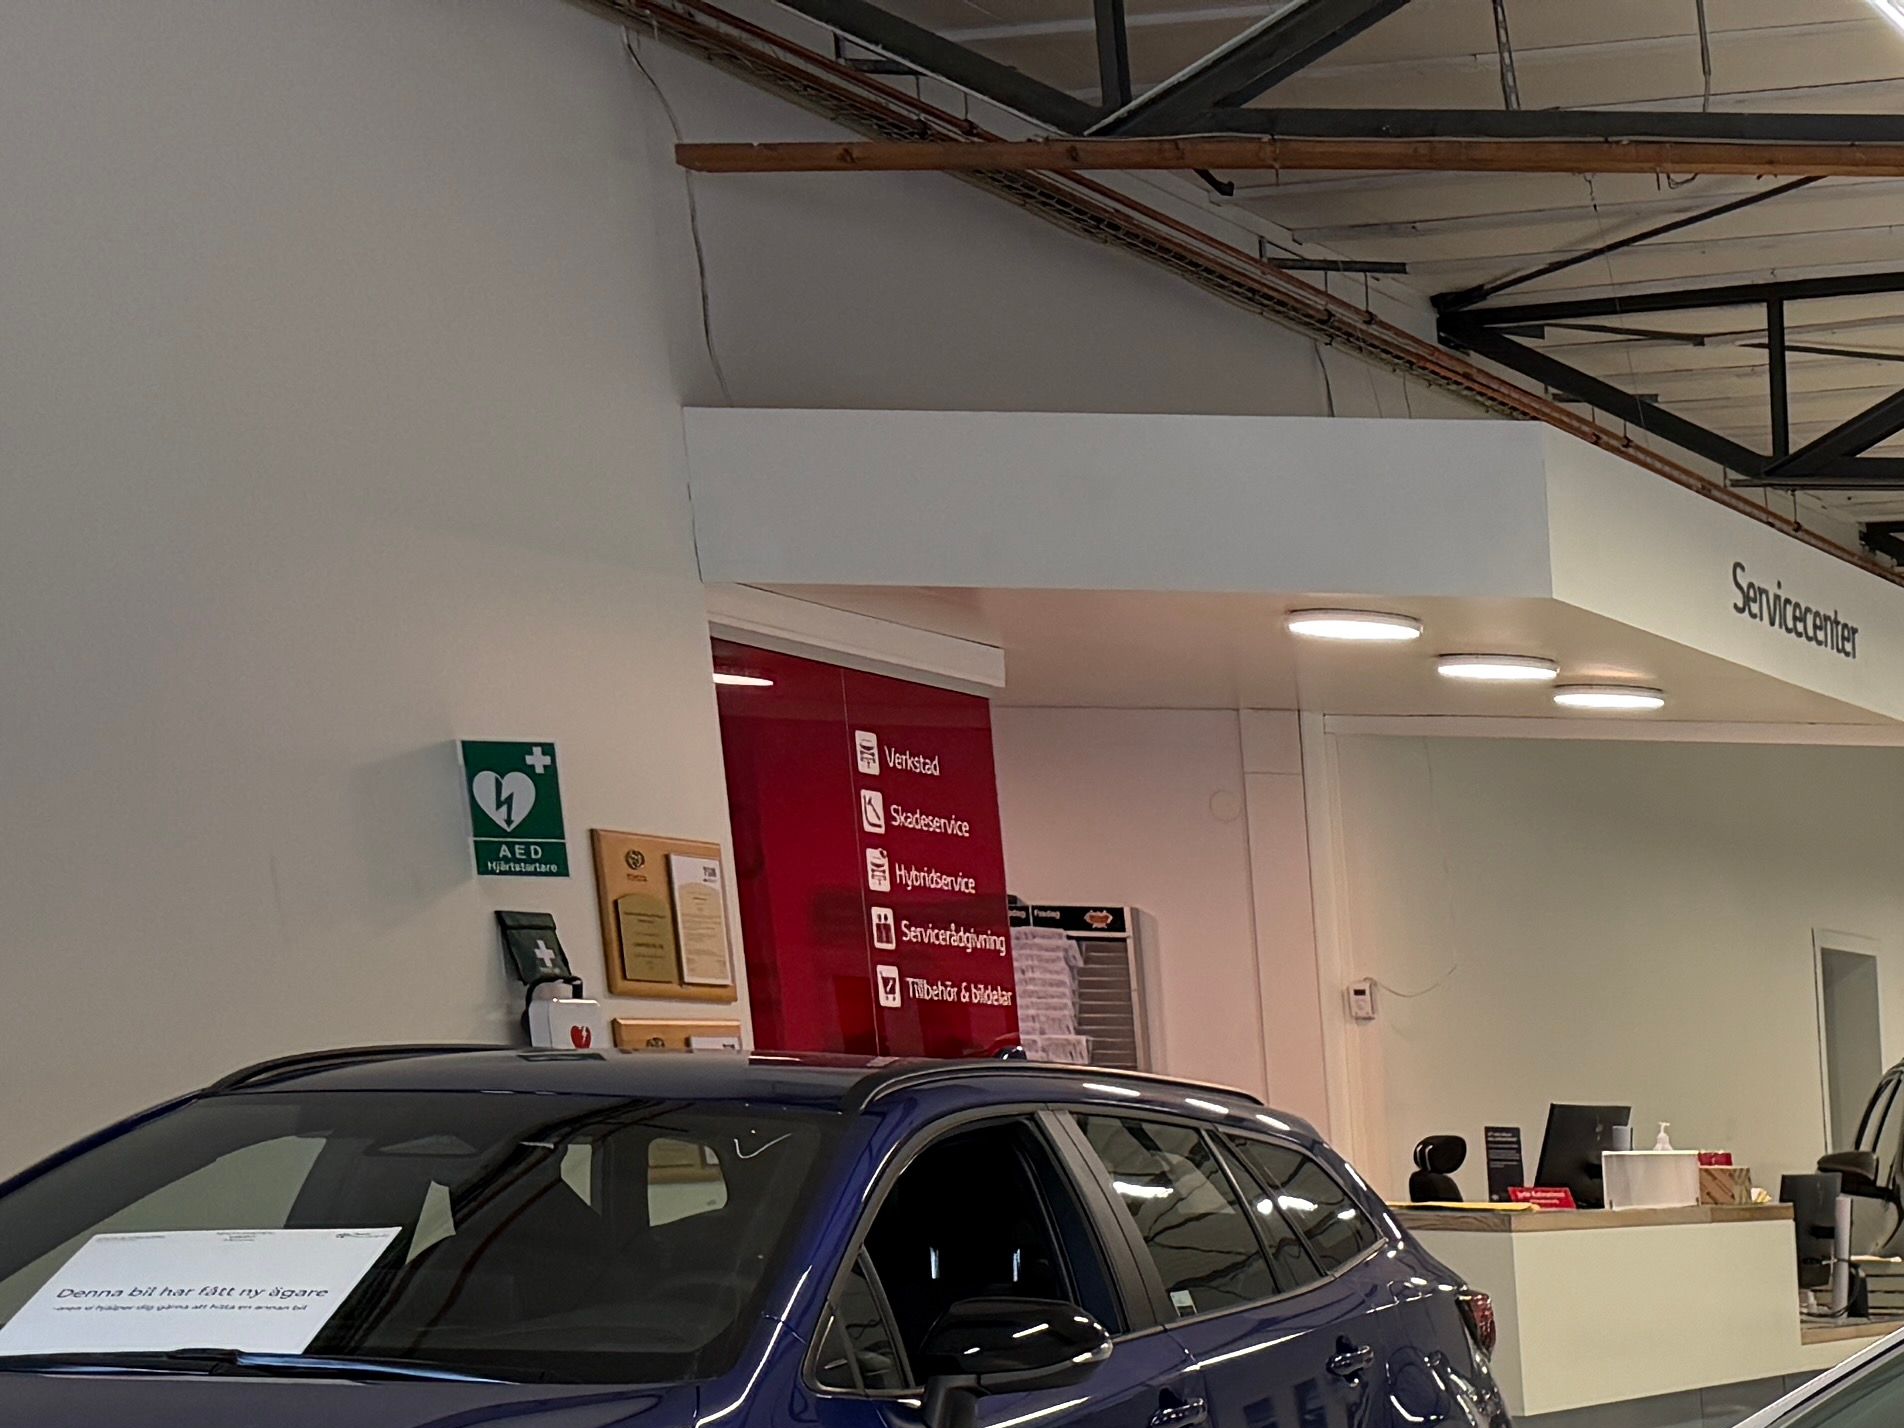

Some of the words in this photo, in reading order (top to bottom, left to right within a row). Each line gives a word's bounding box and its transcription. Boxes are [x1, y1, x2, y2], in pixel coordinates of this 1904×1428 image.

[1732, 561, 1858, 659] Servicecenter
[884, 745, 941, 776] Verkstad
[890, 804, 970, 837] Skadeservice
[487, 861, 558, 873] Hjärtstartare
[499, 844, 542, 859] AED
[895, 862, 976, 894] Hybridservice
[901, 920, 1006, 956] Servicerådgivning
[905, 977, 958, 1002] Tillbehör
[960, 982, 969, 1003] &
[971, 983, 1012, 1006] bildelar
[56, 1288, 124, 1298] Denna
[128, 1286, 157, 1297] bil
[159, 1286, 195, 1297] har
[198, 1285, 236, 1297] fått
[238, 1289, 266, 1299] ny
[268, 1286, 330, 1299] ägare
